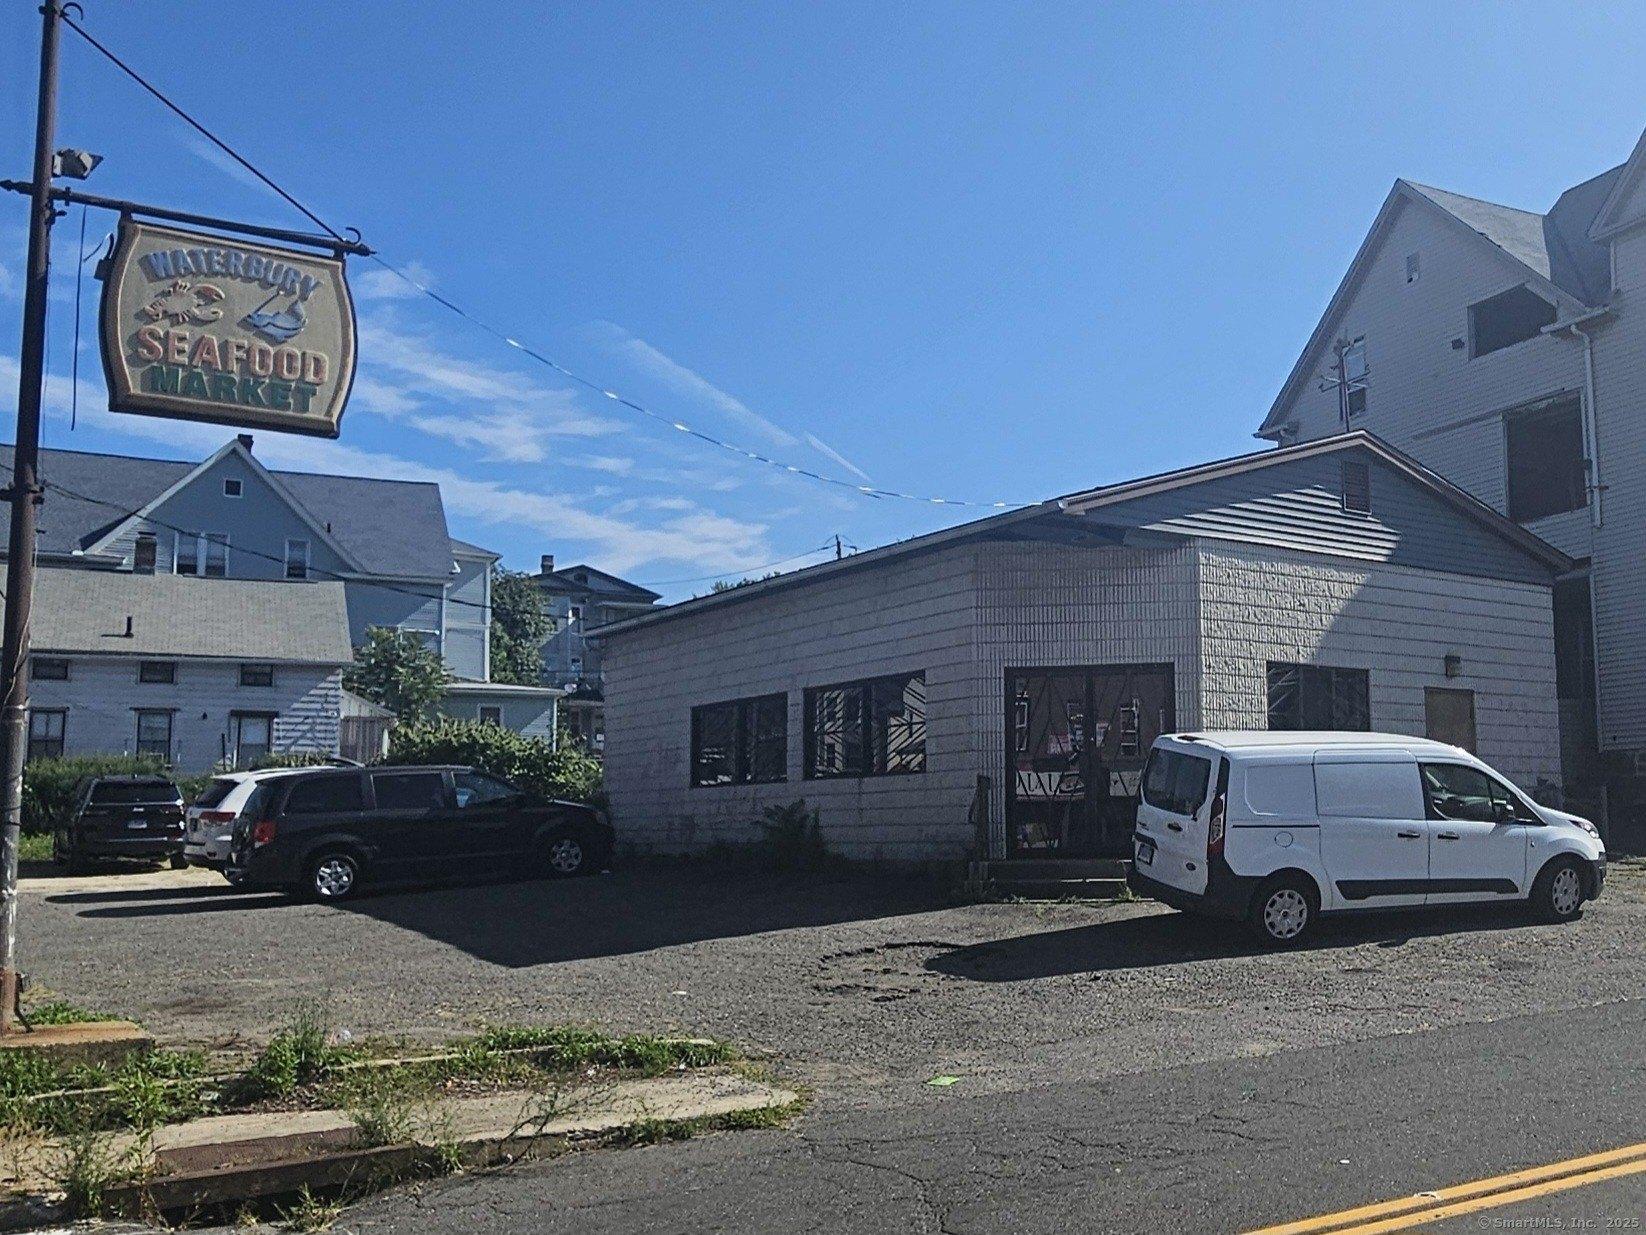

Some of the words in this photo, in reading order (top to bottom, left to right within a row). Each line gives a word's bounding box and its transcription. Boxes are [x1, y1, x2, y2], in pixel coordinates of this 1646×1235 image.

[140, 248, 323, 302] WATERBURY
[136, 325, 329, 386] SEAFOOD
[142, 365, 319, 412] MARKET
